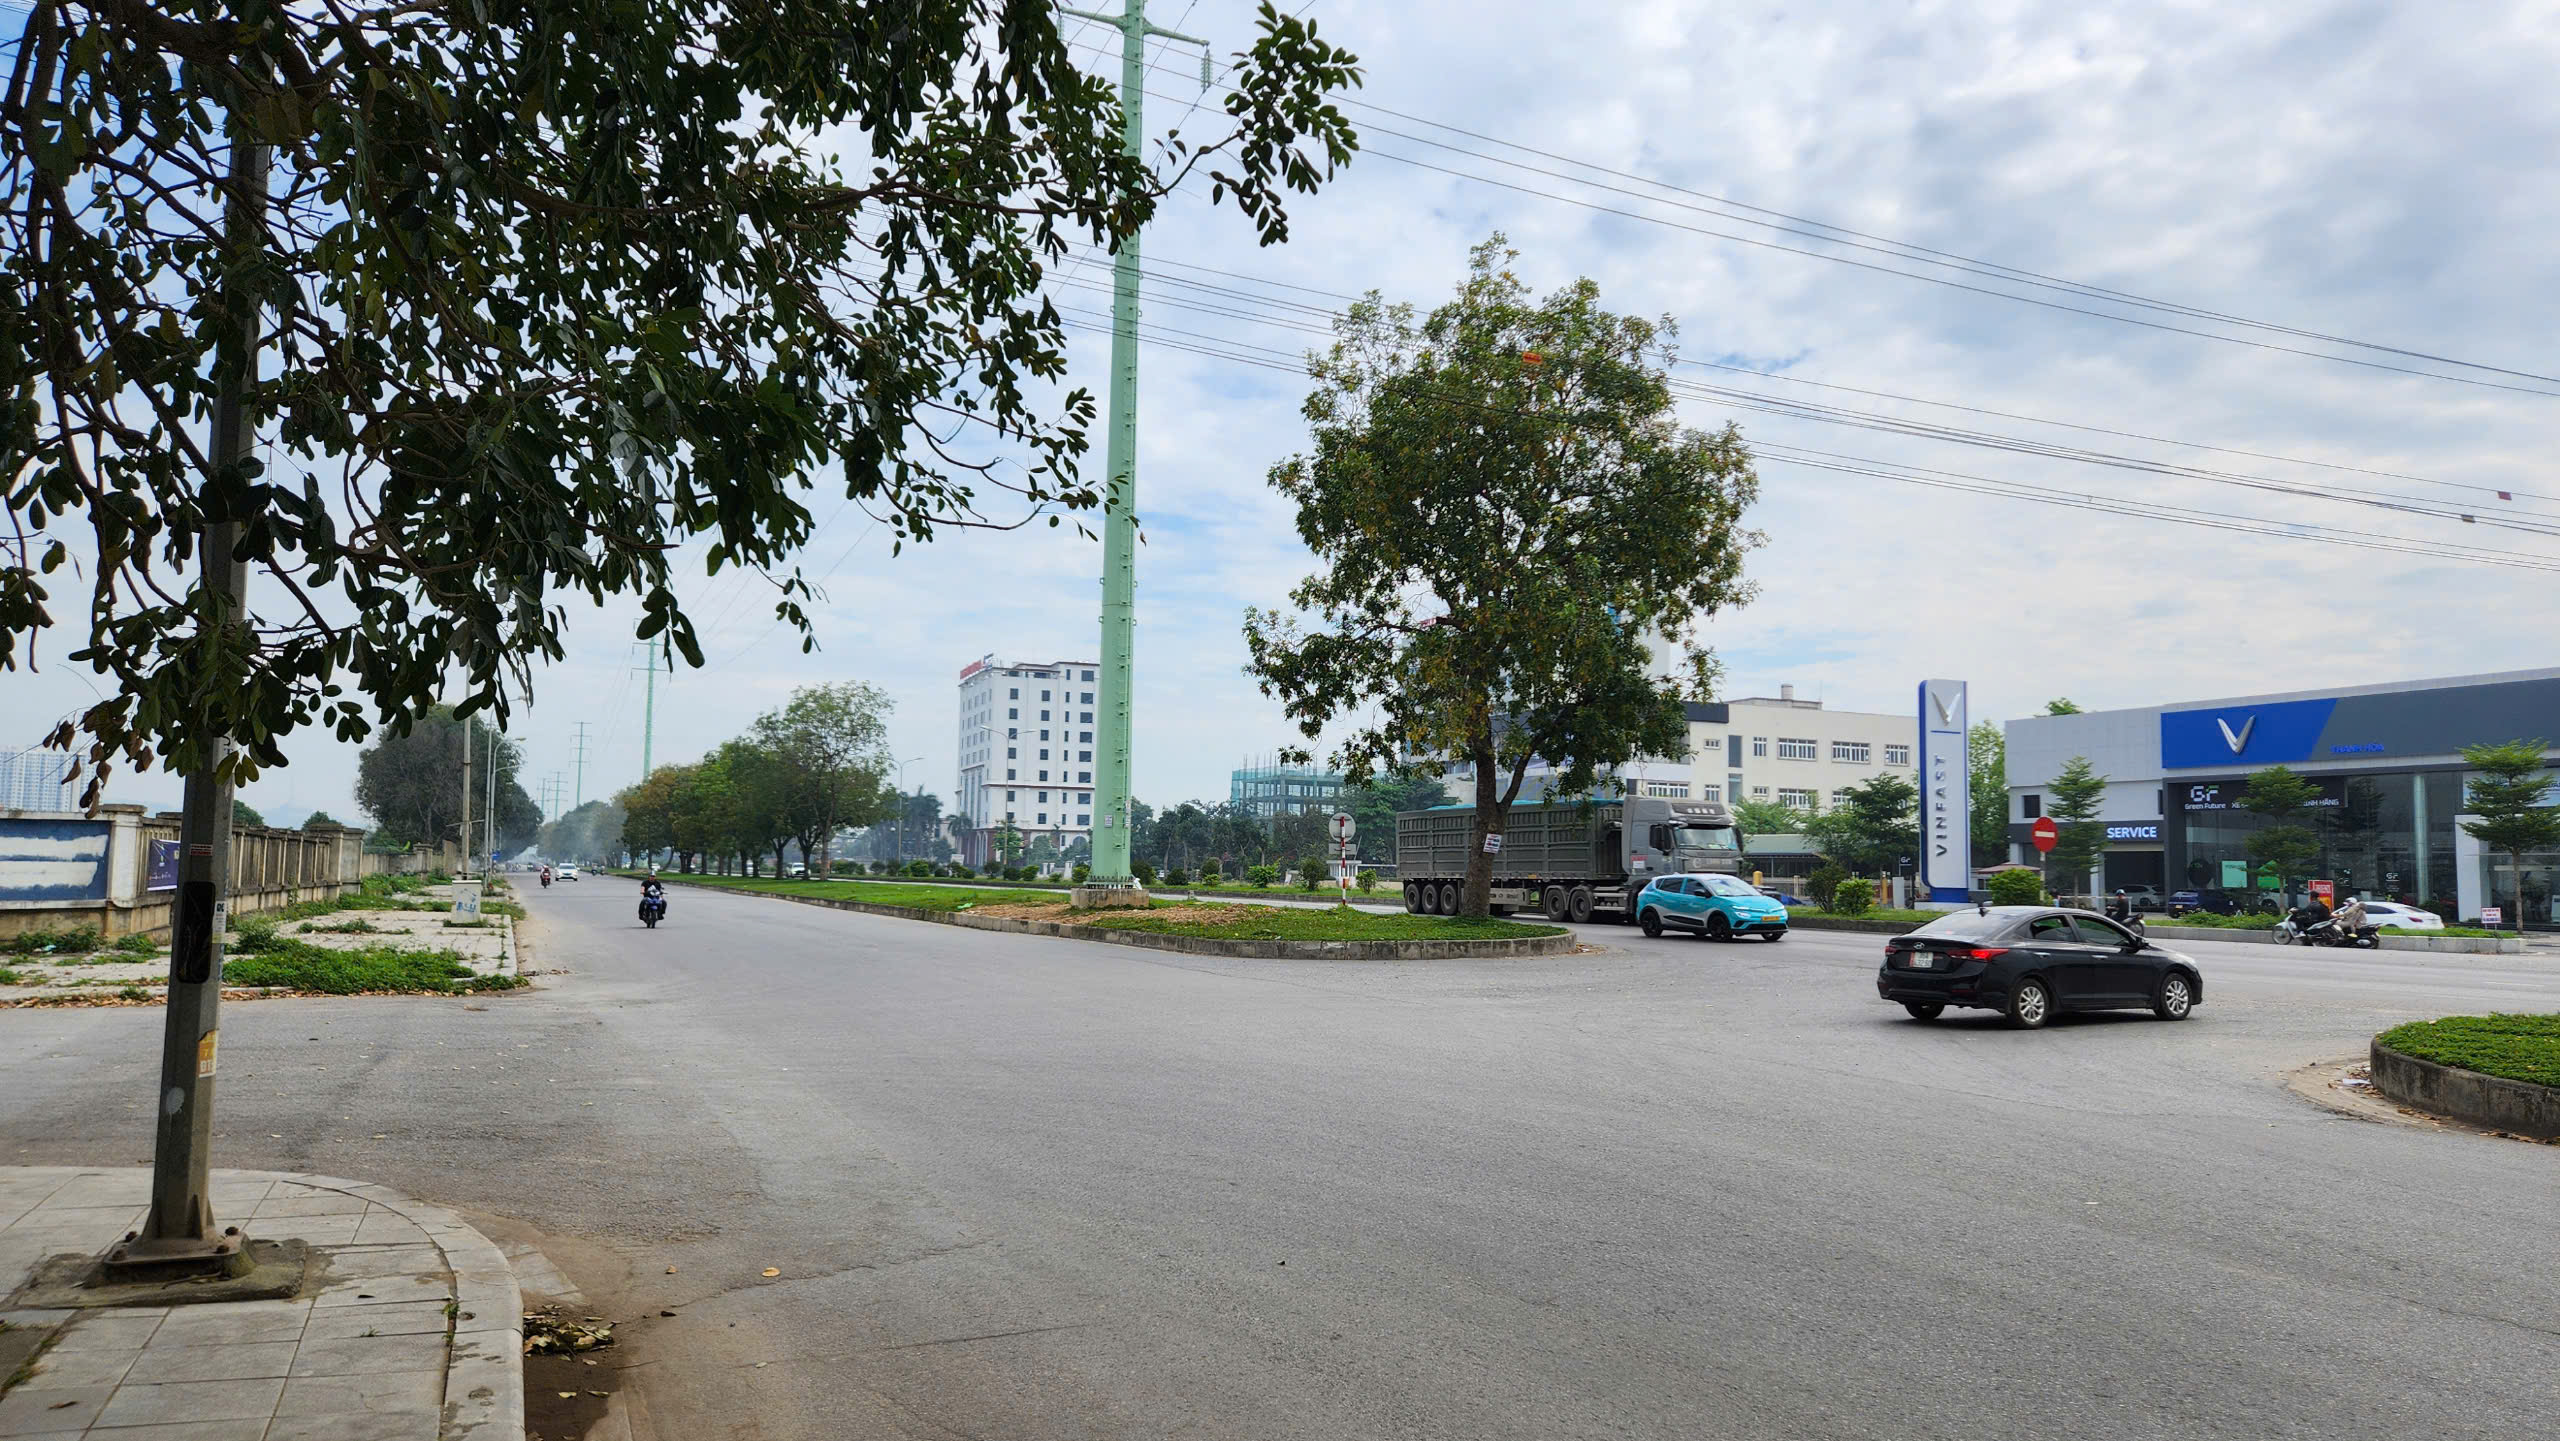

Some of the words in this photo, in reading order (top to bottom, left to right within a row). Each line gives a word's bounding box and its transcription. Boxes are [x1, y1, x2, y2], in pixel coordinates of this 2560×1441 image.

[1934, 754, 1948, 858] VINFAST
[2184, 803, 2204, 811] Green
[2204, 801, 2226, 810] Future
[2106, 826, 2157, 839] SERVICE
